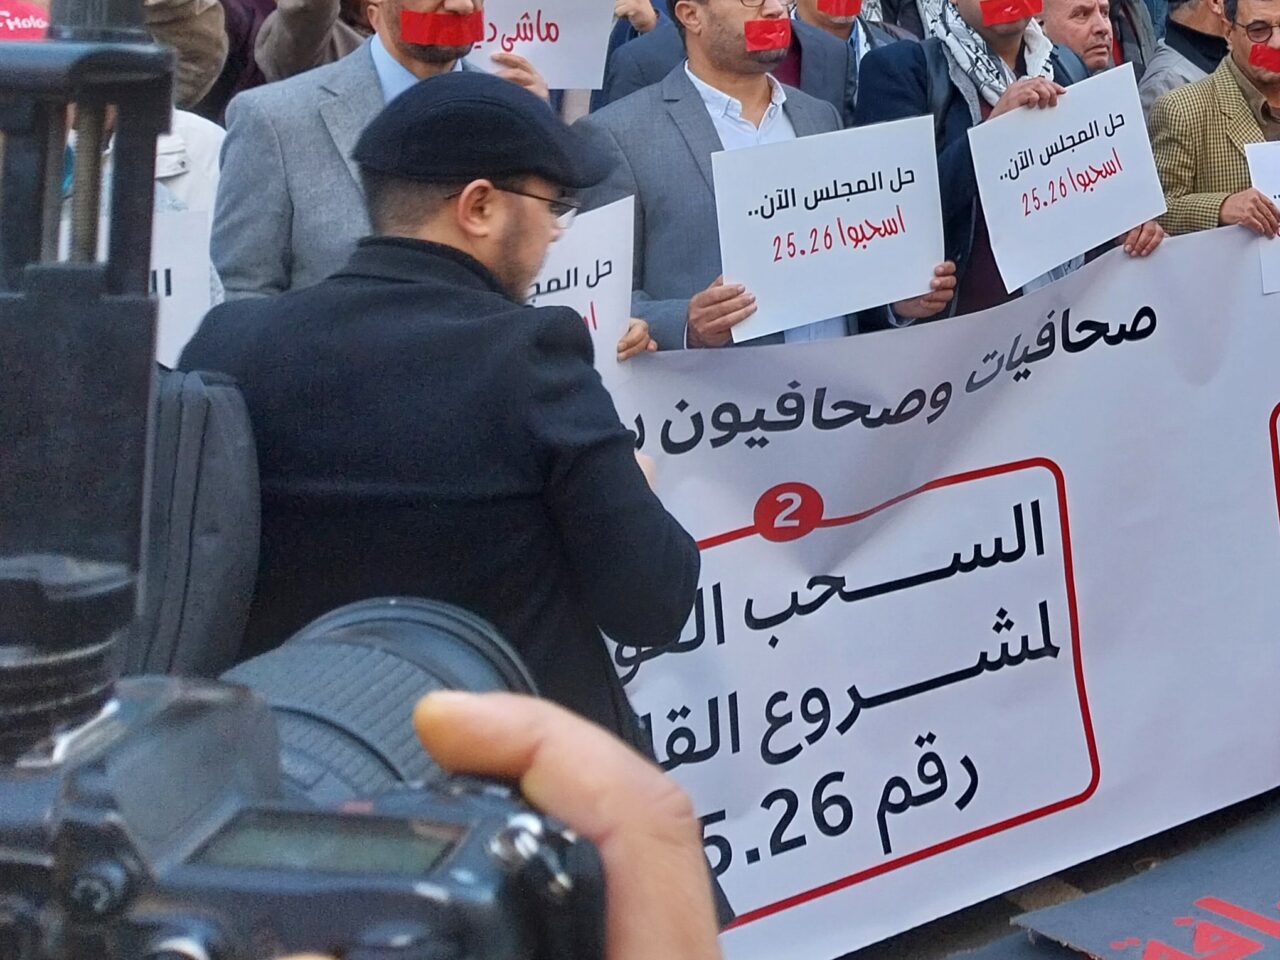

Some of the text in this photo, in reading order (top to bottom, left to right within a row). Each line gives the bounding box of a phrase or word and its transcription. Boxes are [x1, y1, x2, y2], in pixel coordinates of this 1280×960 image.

[1040, 120, 1099, 166] المجلس
[1104, 113, 1125, 137] حل
[804, 171, 883, 210] المجلس
[889, 167, 915, 193] حل
[1022, 147, 1123, 216] اسحبوا 25.26
[773, 205, 906, 262] اسحبوا 25.26
[586, 259, 612, 288] حل
[965, 304, 1158, 395] صحافيات
[660, 379, 952, 455] وصحافيون
[774, 492, 803, 528] 2
[744, 499, 1046, 648] السحب
[760, 600, 1062, 766] لمشروع
[700, 731, 979, 877] رقم 5.26
